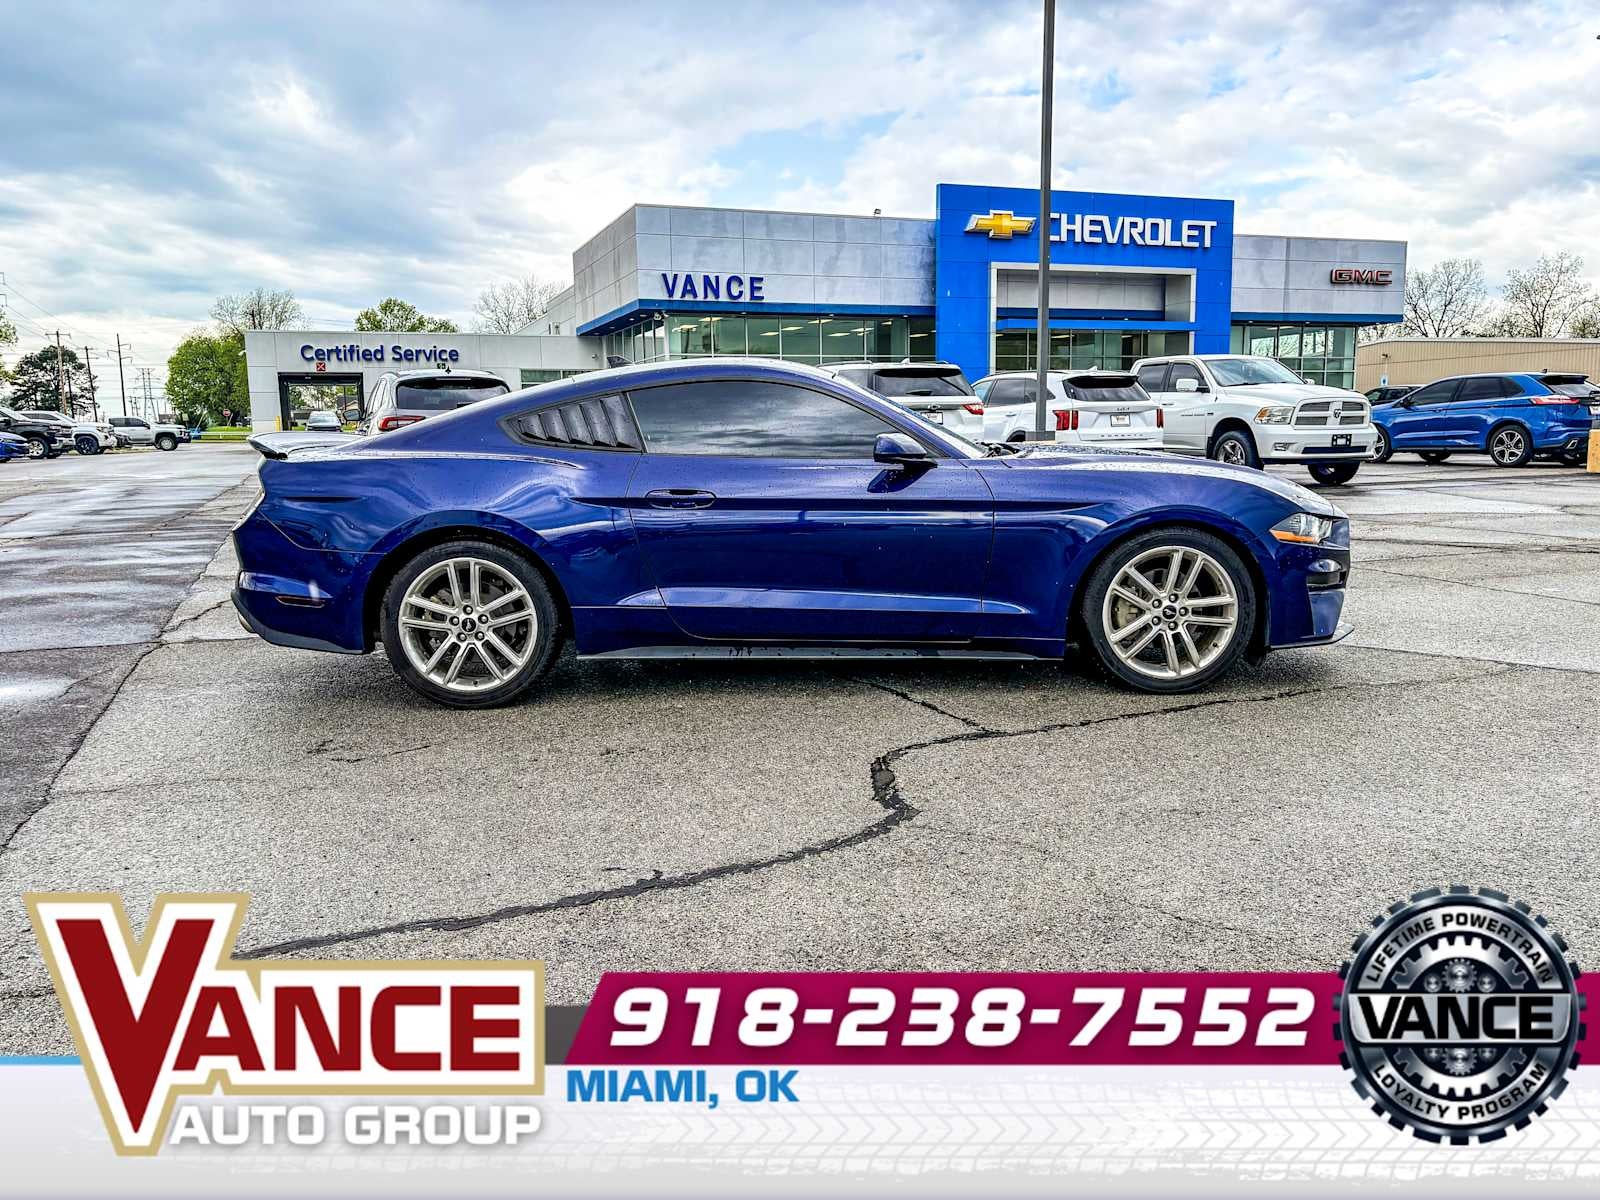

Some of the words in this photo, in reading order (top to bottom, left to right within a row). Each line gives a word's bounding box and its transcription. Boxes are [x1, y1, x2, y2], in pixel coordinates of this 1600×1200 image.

[1330, 269, 1393, 285] GMC
[661, 273, 765, 301] VANCE
[300, 344, 384, 362] Certified
[392, 345, 459, 362] Service
